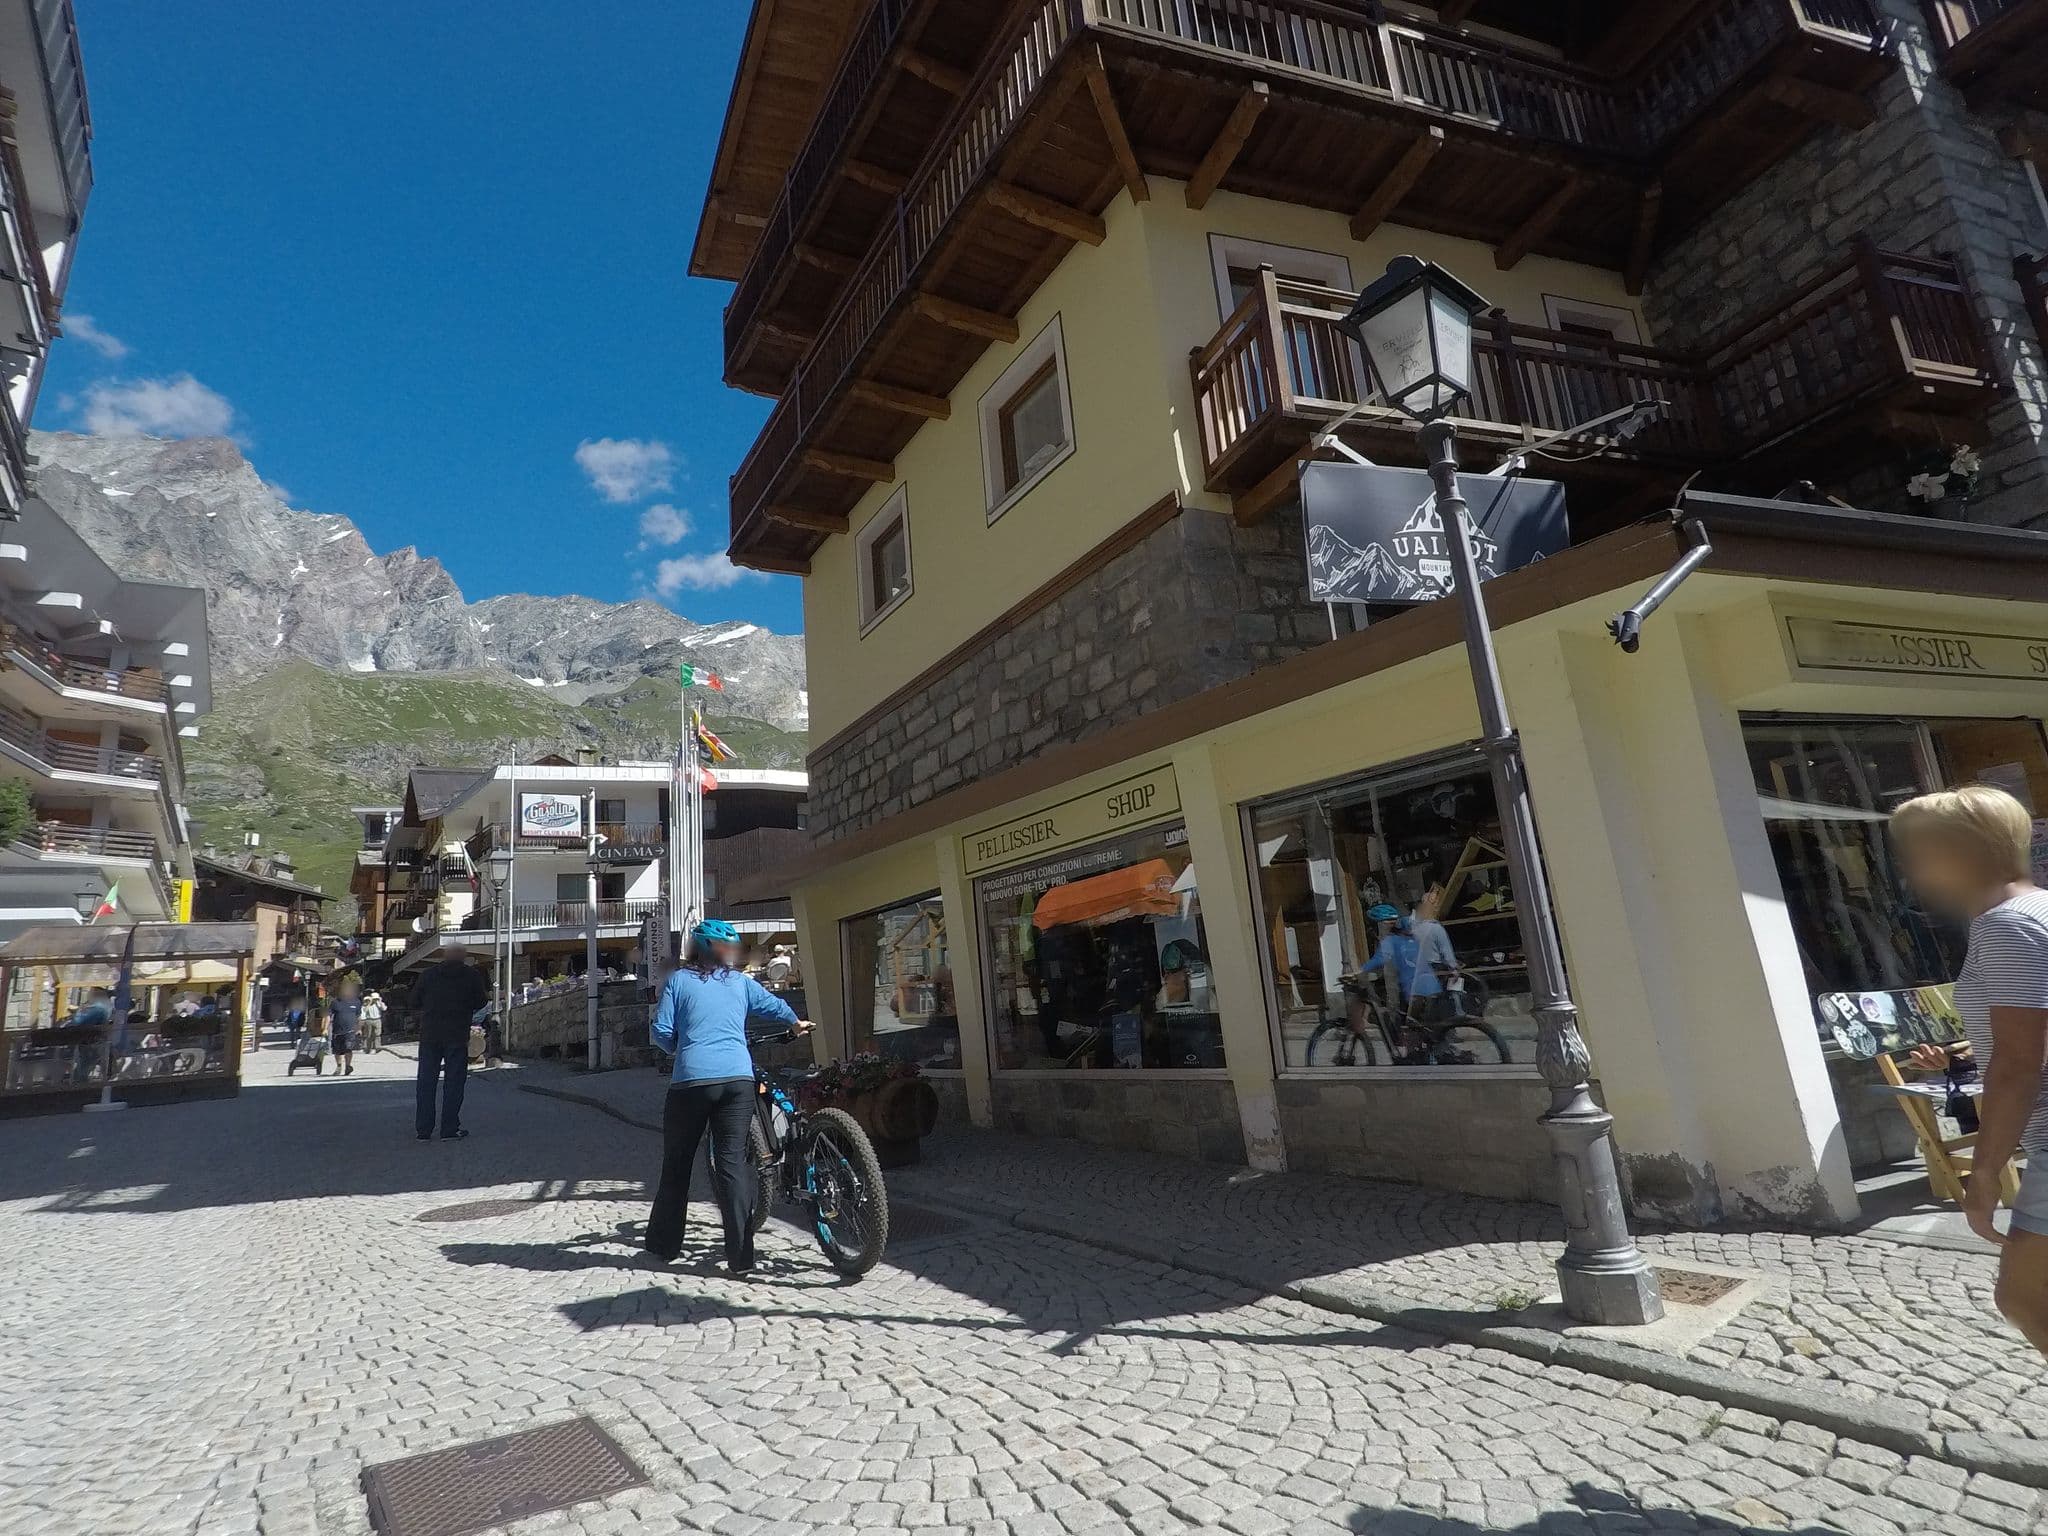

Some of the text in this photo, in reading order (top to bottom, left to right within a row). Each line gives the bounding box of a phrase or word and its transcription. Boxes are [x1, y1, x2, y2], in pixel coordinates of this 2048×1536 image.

[1421, 563, 1450, 573] MOUNTAI
[977, 783, 1155, 861] PELLISSIER SHOP
[598, 847, 653, 859] CINEMA
[982, 873, 1023, 891] PROGETTATO
[1024, 871, 1037, 882] PER
[1038, 858, 1082, 878] CONDIZIONI
[983, 892, 989, 903] IL
[990, 887, 1013, 901] NUOVO
